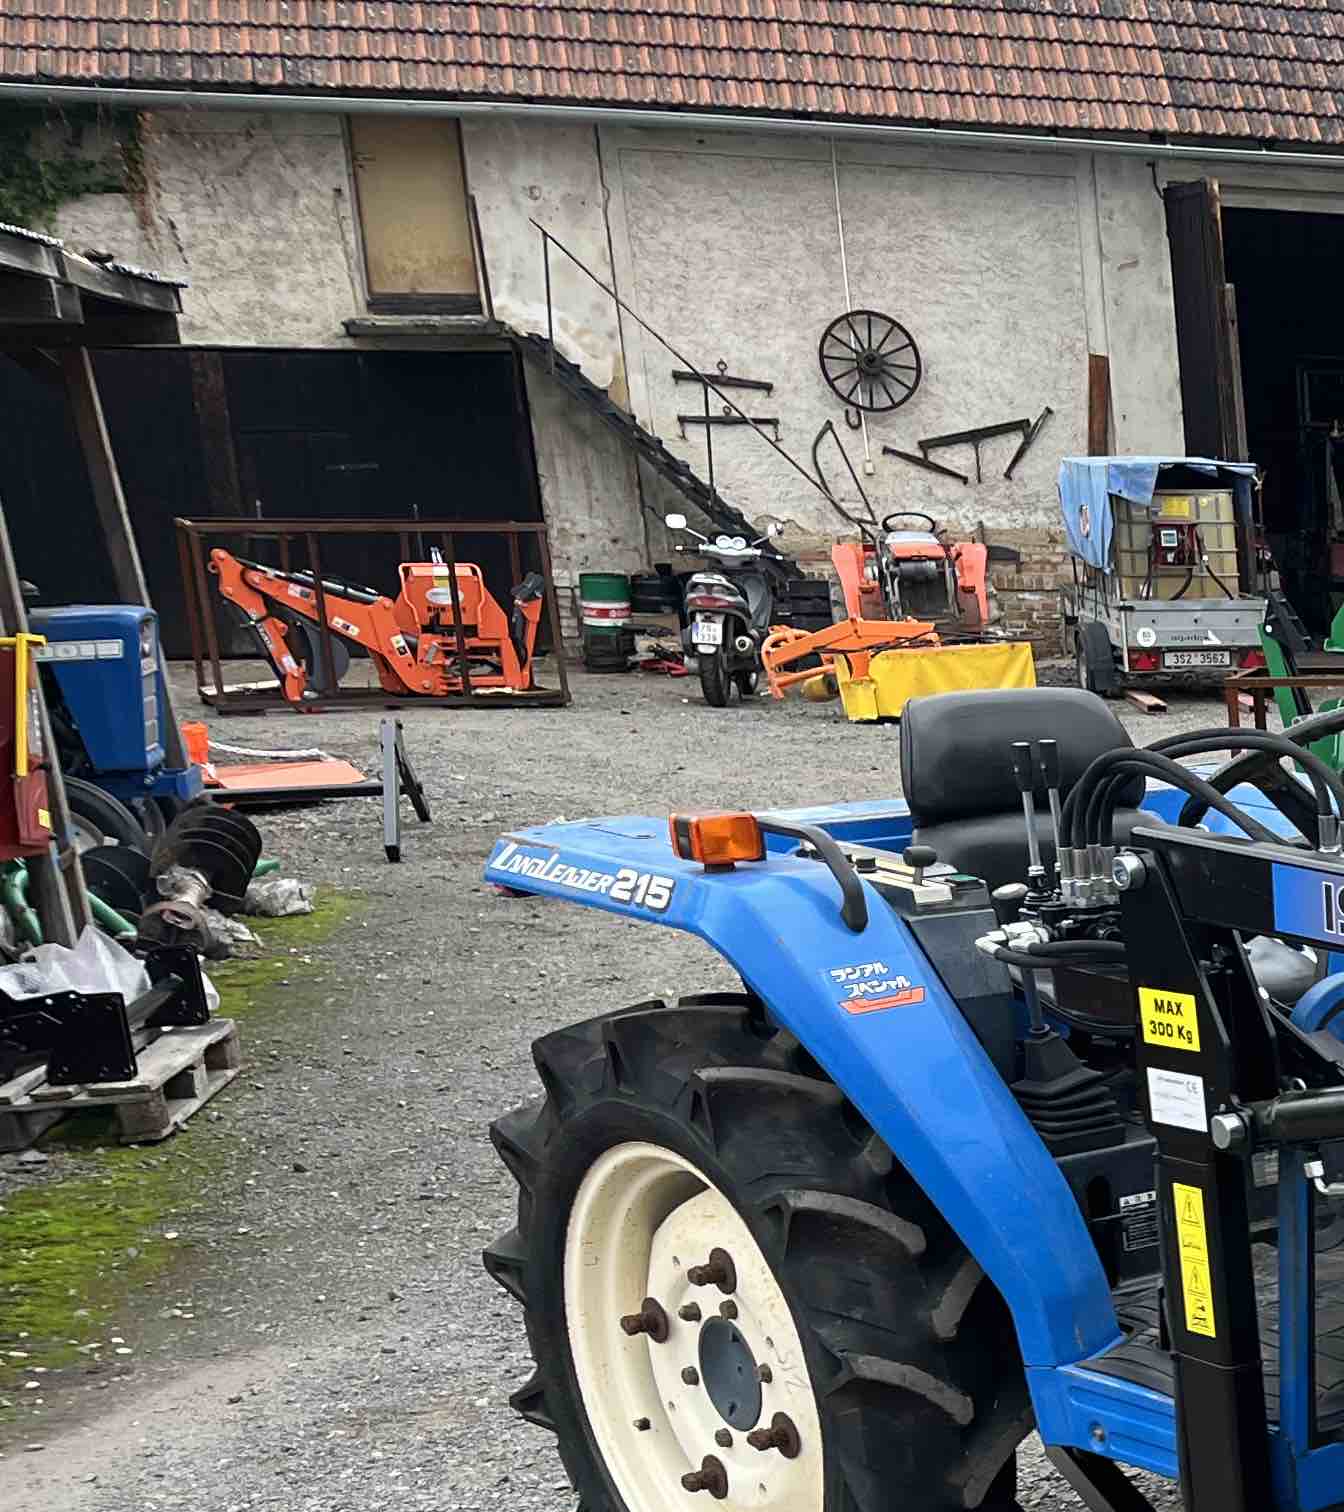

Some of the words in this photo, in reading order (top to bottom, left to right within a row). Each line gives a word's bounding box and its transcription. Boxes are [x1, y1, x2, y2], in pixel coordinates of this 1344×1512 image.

[608, 867, 676, 911] 215
[1153, 998, 1184, 1017] MAX
[1149, 1020, 1174, 1038] 300
[1177, 1024, 1194, 1044] Kg
